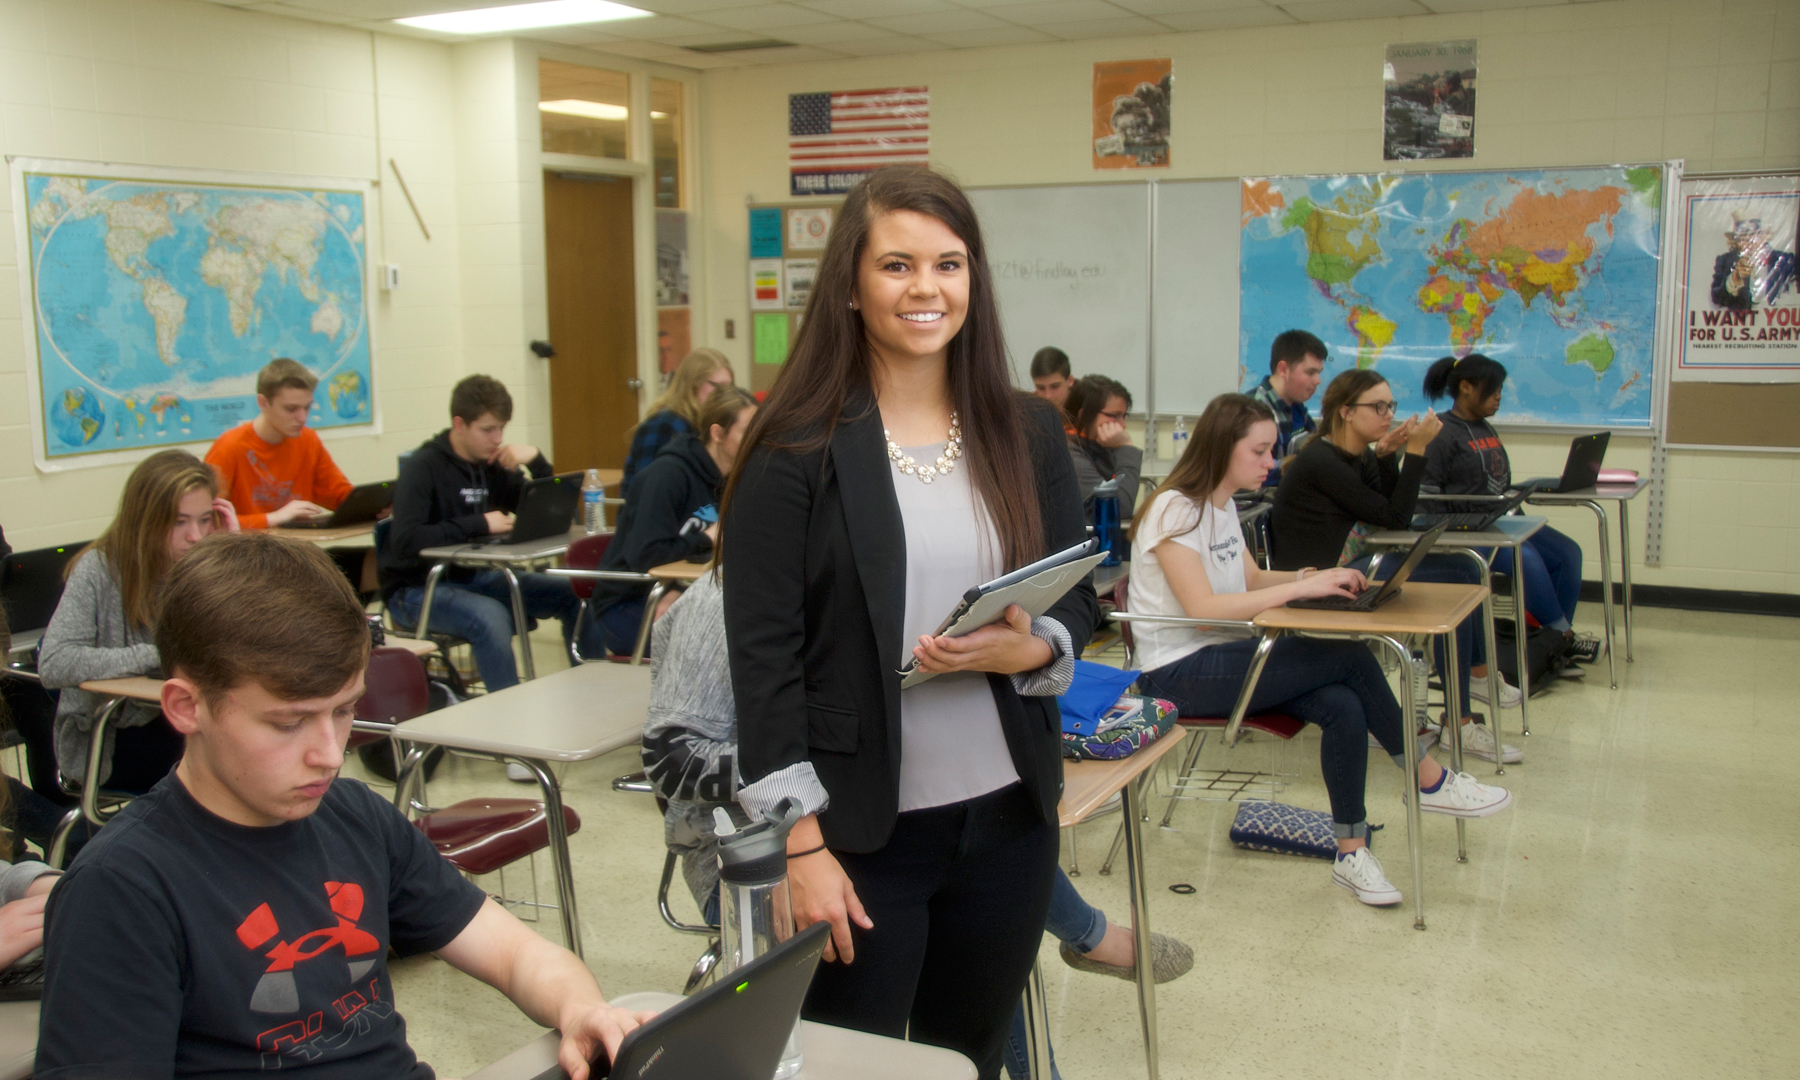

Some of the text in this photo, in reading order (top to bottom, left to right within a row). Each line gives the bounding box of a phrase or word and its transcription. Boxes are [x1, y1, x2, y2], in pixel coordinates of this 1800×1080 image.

[1390, 48, 1432, 58] JANUARY
[1453, 45, 1473, 55] 1968
[794, 174, 826, 190] THESE
[1690, 307, 1800, 326] I WANT YOU
[1690, 328, 1716, 341] FOR
[1756, 327, 1800, 341] ARMY
[638, 1045, 665, 1077] ThinkPad
